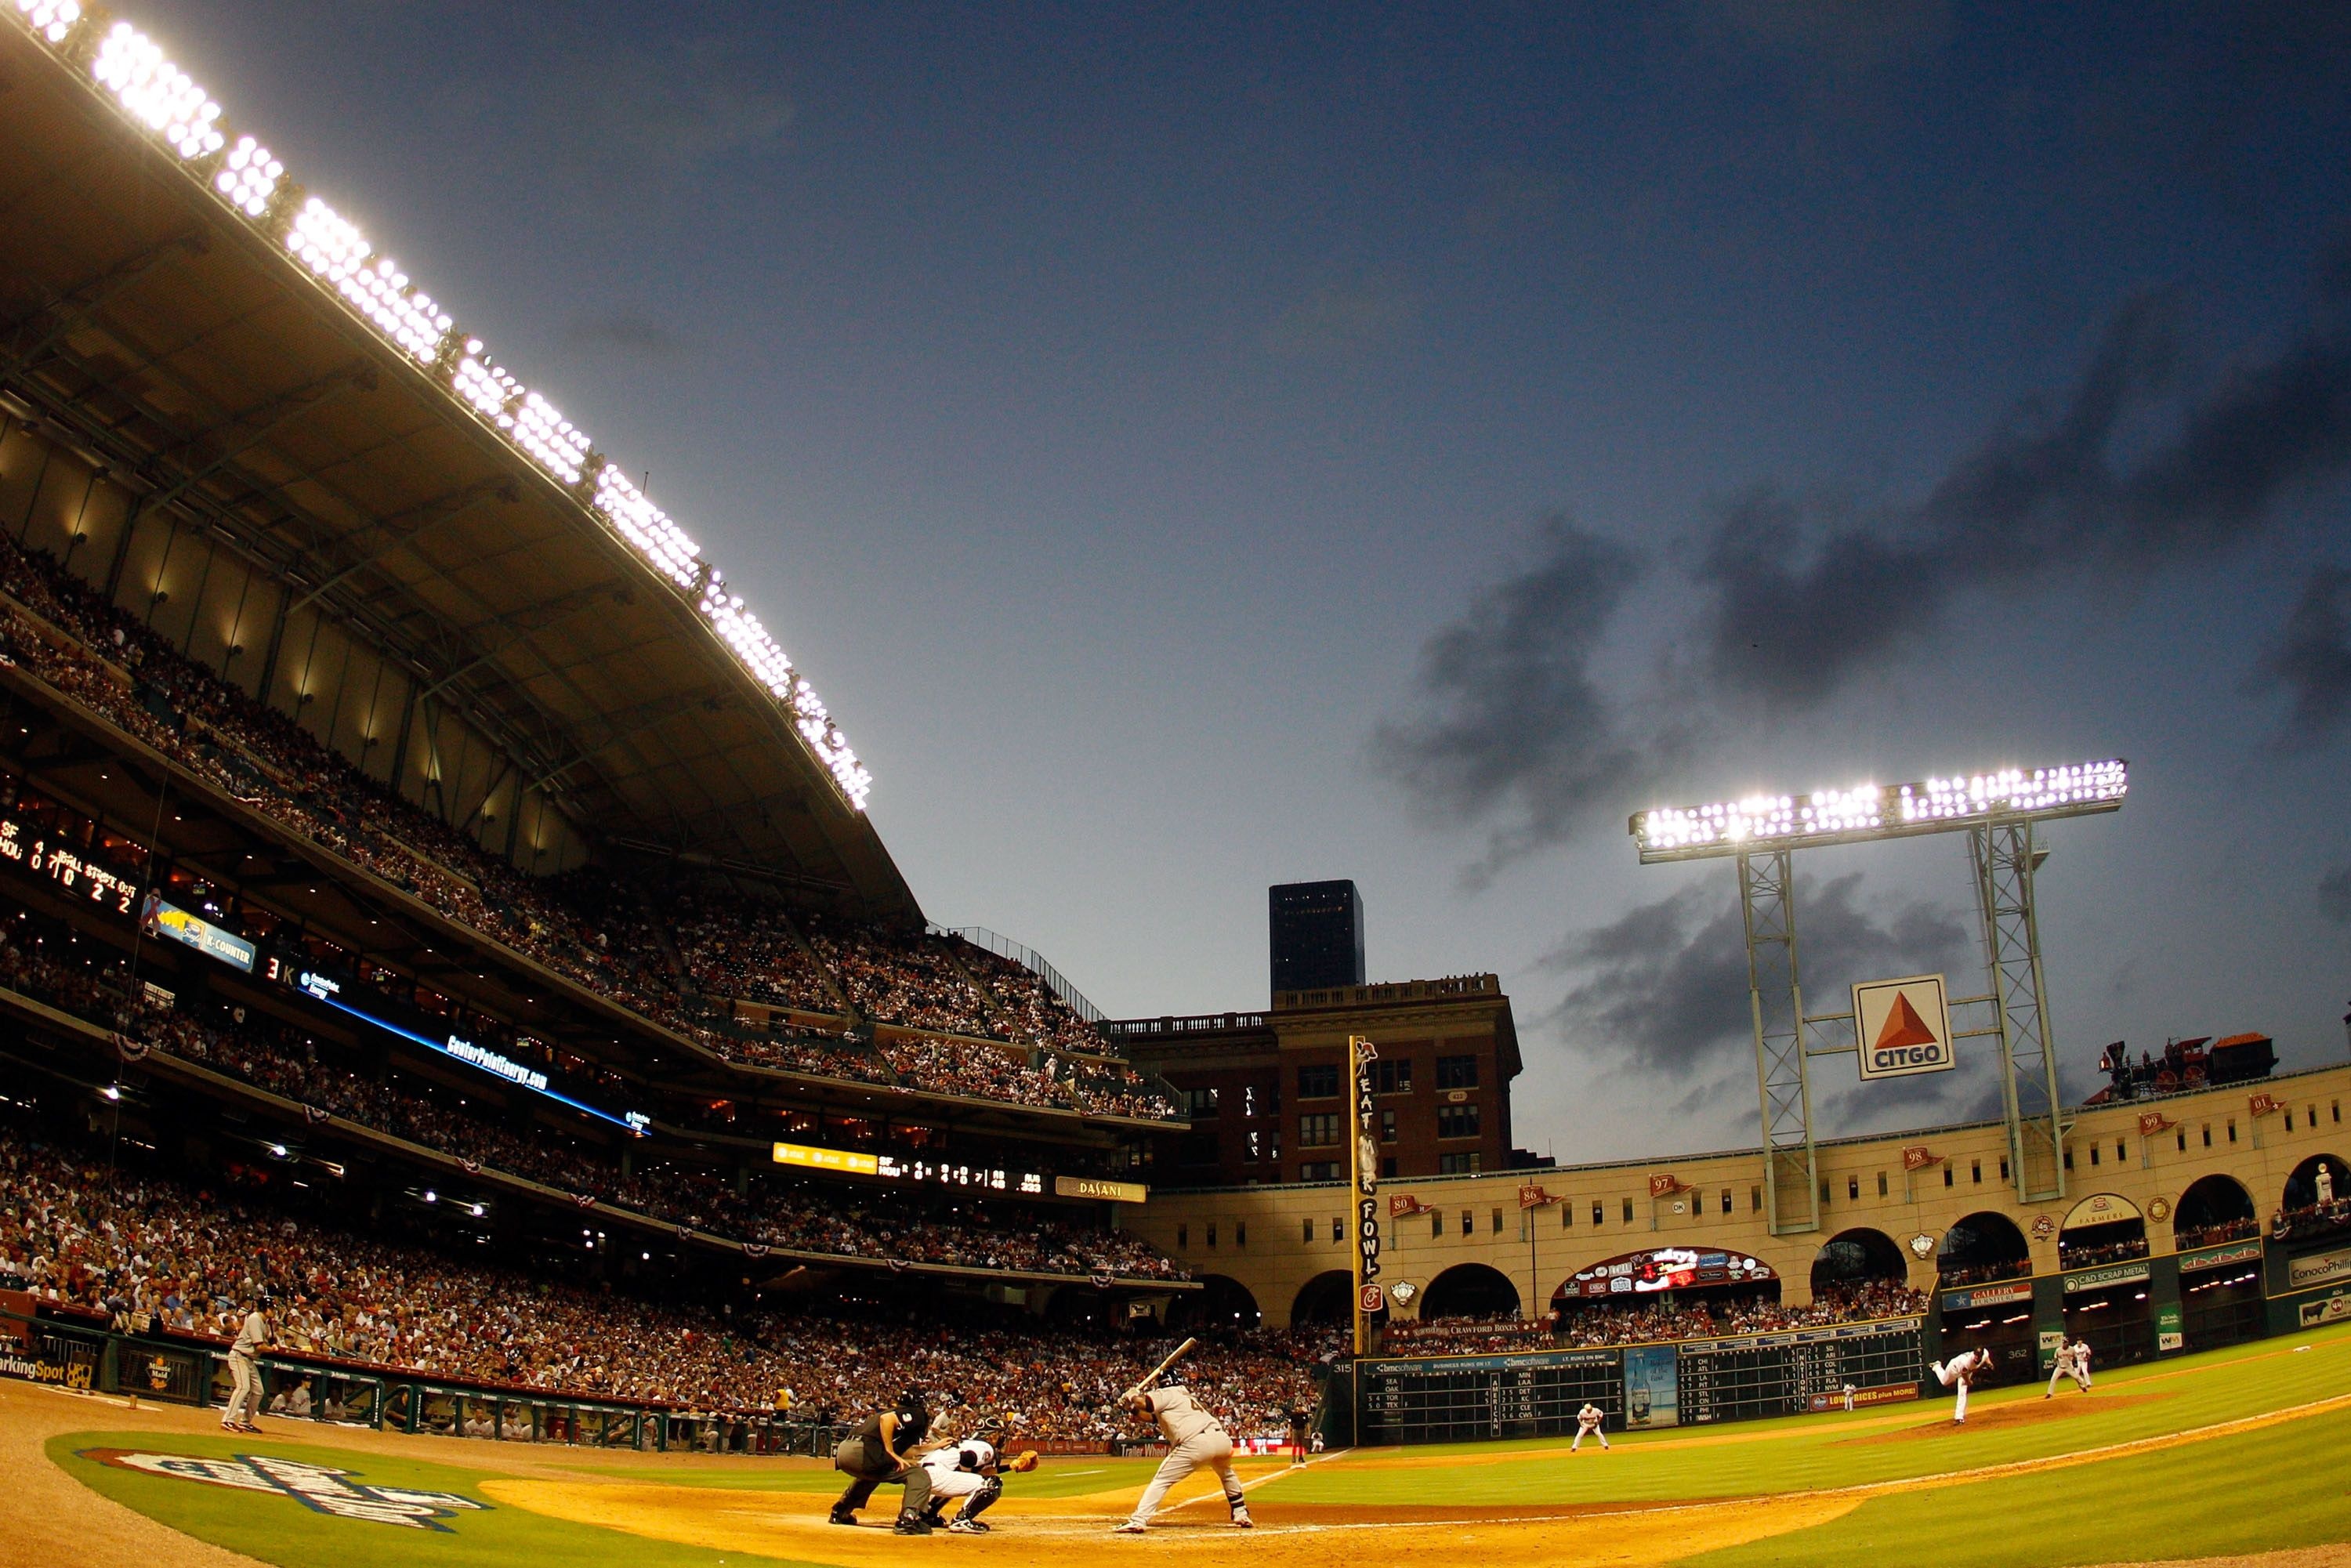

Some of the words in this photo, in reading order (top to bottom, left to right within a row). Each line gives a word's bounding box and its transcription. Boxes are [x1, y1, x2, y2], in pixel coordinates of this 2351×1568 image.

[1, 820, 20, 838] SF
[35, 841, 44, 854] 4
[31, 854, 42, 870] 0
[49, 853, 58, 869] 7
[63, 868, 75, 886] 0
[92, 882, 104, 901] 2
[118, 896, 131, 914] 2
[118, 881, 137, 899] OUT
[206, 935, 251, 964] K-COUNTER
[267, 957, 280, 980] 3
[283, 964, 295, 986] K
[447, 1034, 548, 1091] CenterPointEnergy.com
[1874, 1045, 1940, 1067] CITGO
[1360, 1077, 1374, 1130] EAT
[878, 1156, 894, 1166] SF
[915, 1161, 923, 1171] 4
[1908, 1150, 1922, 1163] 98
[878, 1165, 900, 1178] HOU
[975, 1172, 984, 1182] 7
[1079, 1181, 1121, 1197] DASANI
[1654, 1179, 1669, 1190] 97
[1523, 1190, 1538, 1202] 86
[1394, 1198, 1407, 1210] 80
[2079, 1211, 2125, 1224] FARMERS
[1362, 1202, 1377, 1275] FOWL
[2078, 1274, 2098, 1285] C&D
[2098, 1269, 2123, 1282] SCRAP
[2124, 1265, 2148, 1277] METAL
[1973, 1286, 2016, 1298] GALLERY
[1974, 1295, 2014, 1305] FURNITURE
[1451, 1324, 1493, 1335] CRAWFORD
[1494, 1324, 1519, 1333] BOXES
[2008, 1349, 2027, 1360] 362
[151, 1369, 168, 1379] Maid
[1334, 1363, 1352, 1374] 315
[1853, 1391, 1878, 1401] RICES
[1878, 1391, 1893, 1400] plus
[1893, 1387, 1916, 1396] MORE!
[1121, 1443, 1143, 1458] Trailer
[1144, 1443, 1168, 1458] Wheel
